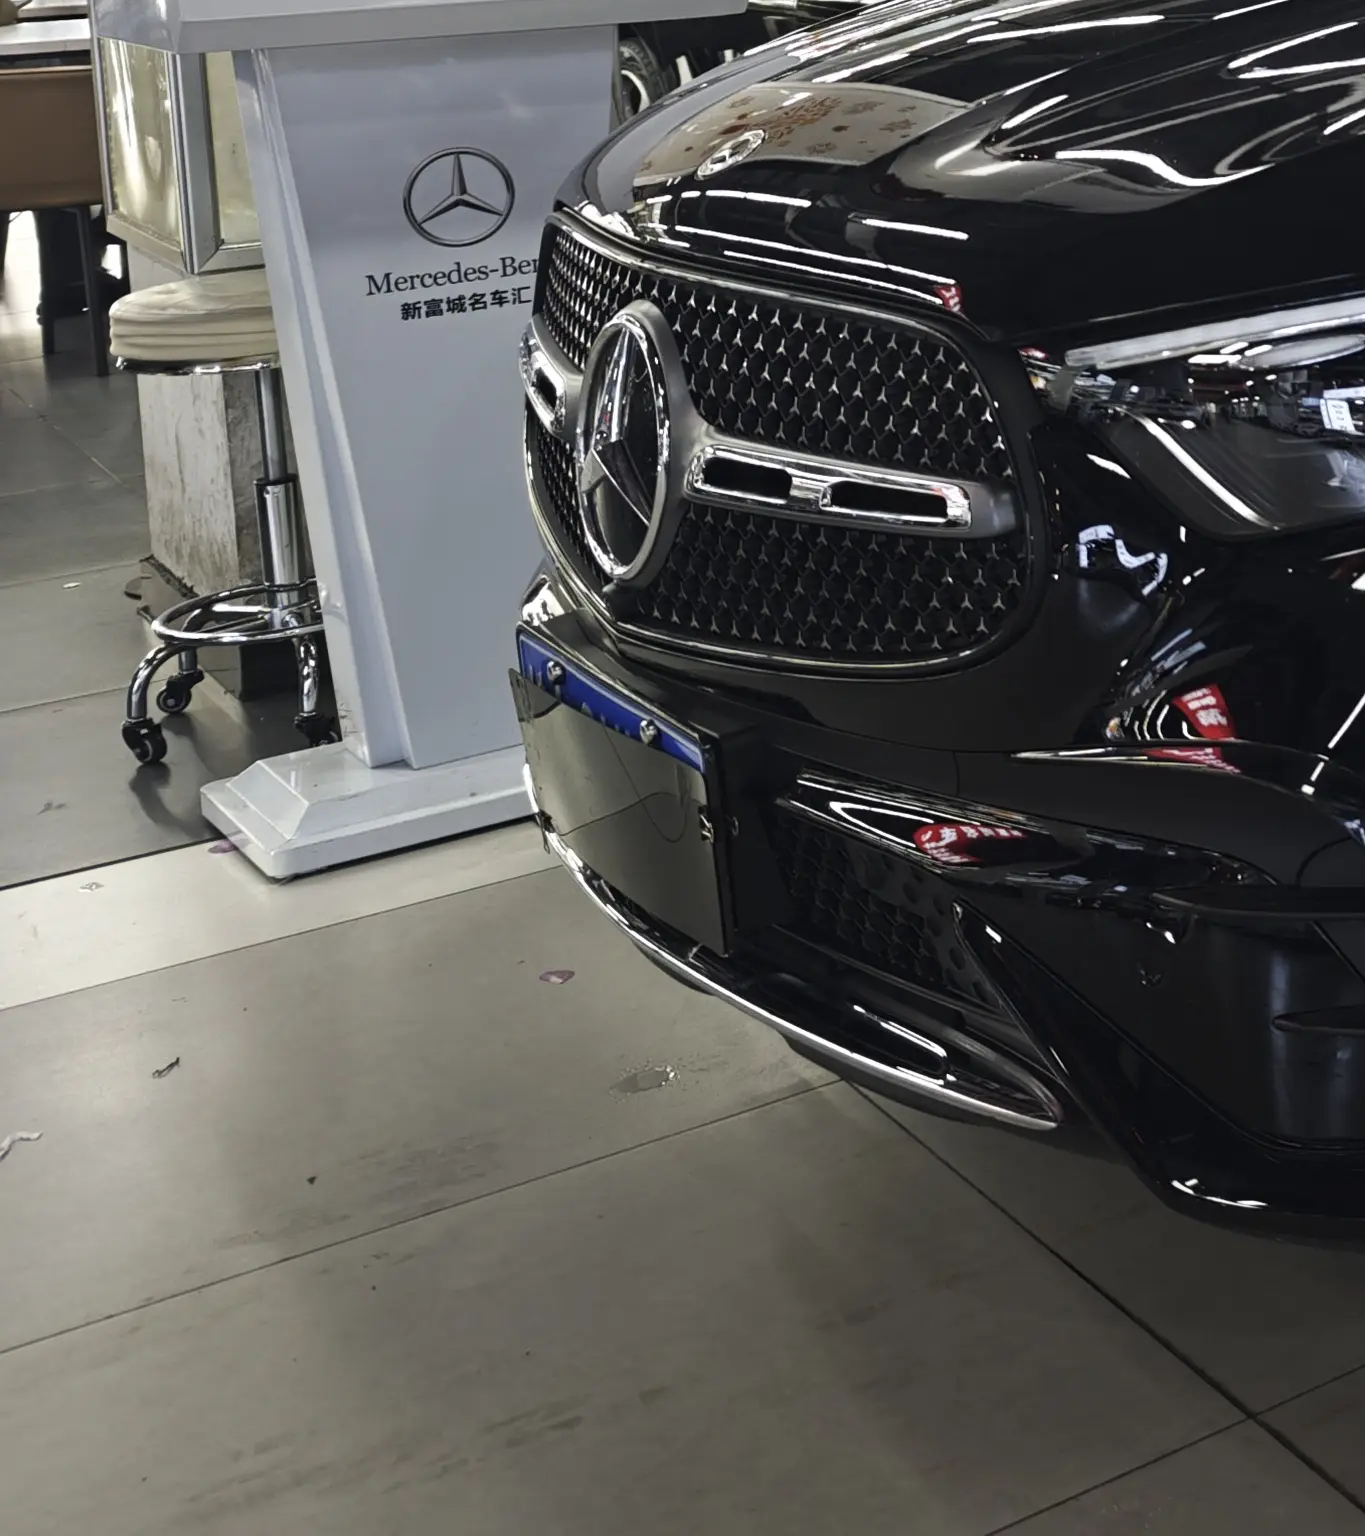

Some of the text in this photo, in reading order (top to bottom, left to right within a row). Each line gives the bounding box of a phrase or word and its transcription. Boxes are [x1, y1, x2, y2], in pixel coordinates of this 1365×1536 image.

[401, 285, 533, 321] 新富城名车汇
